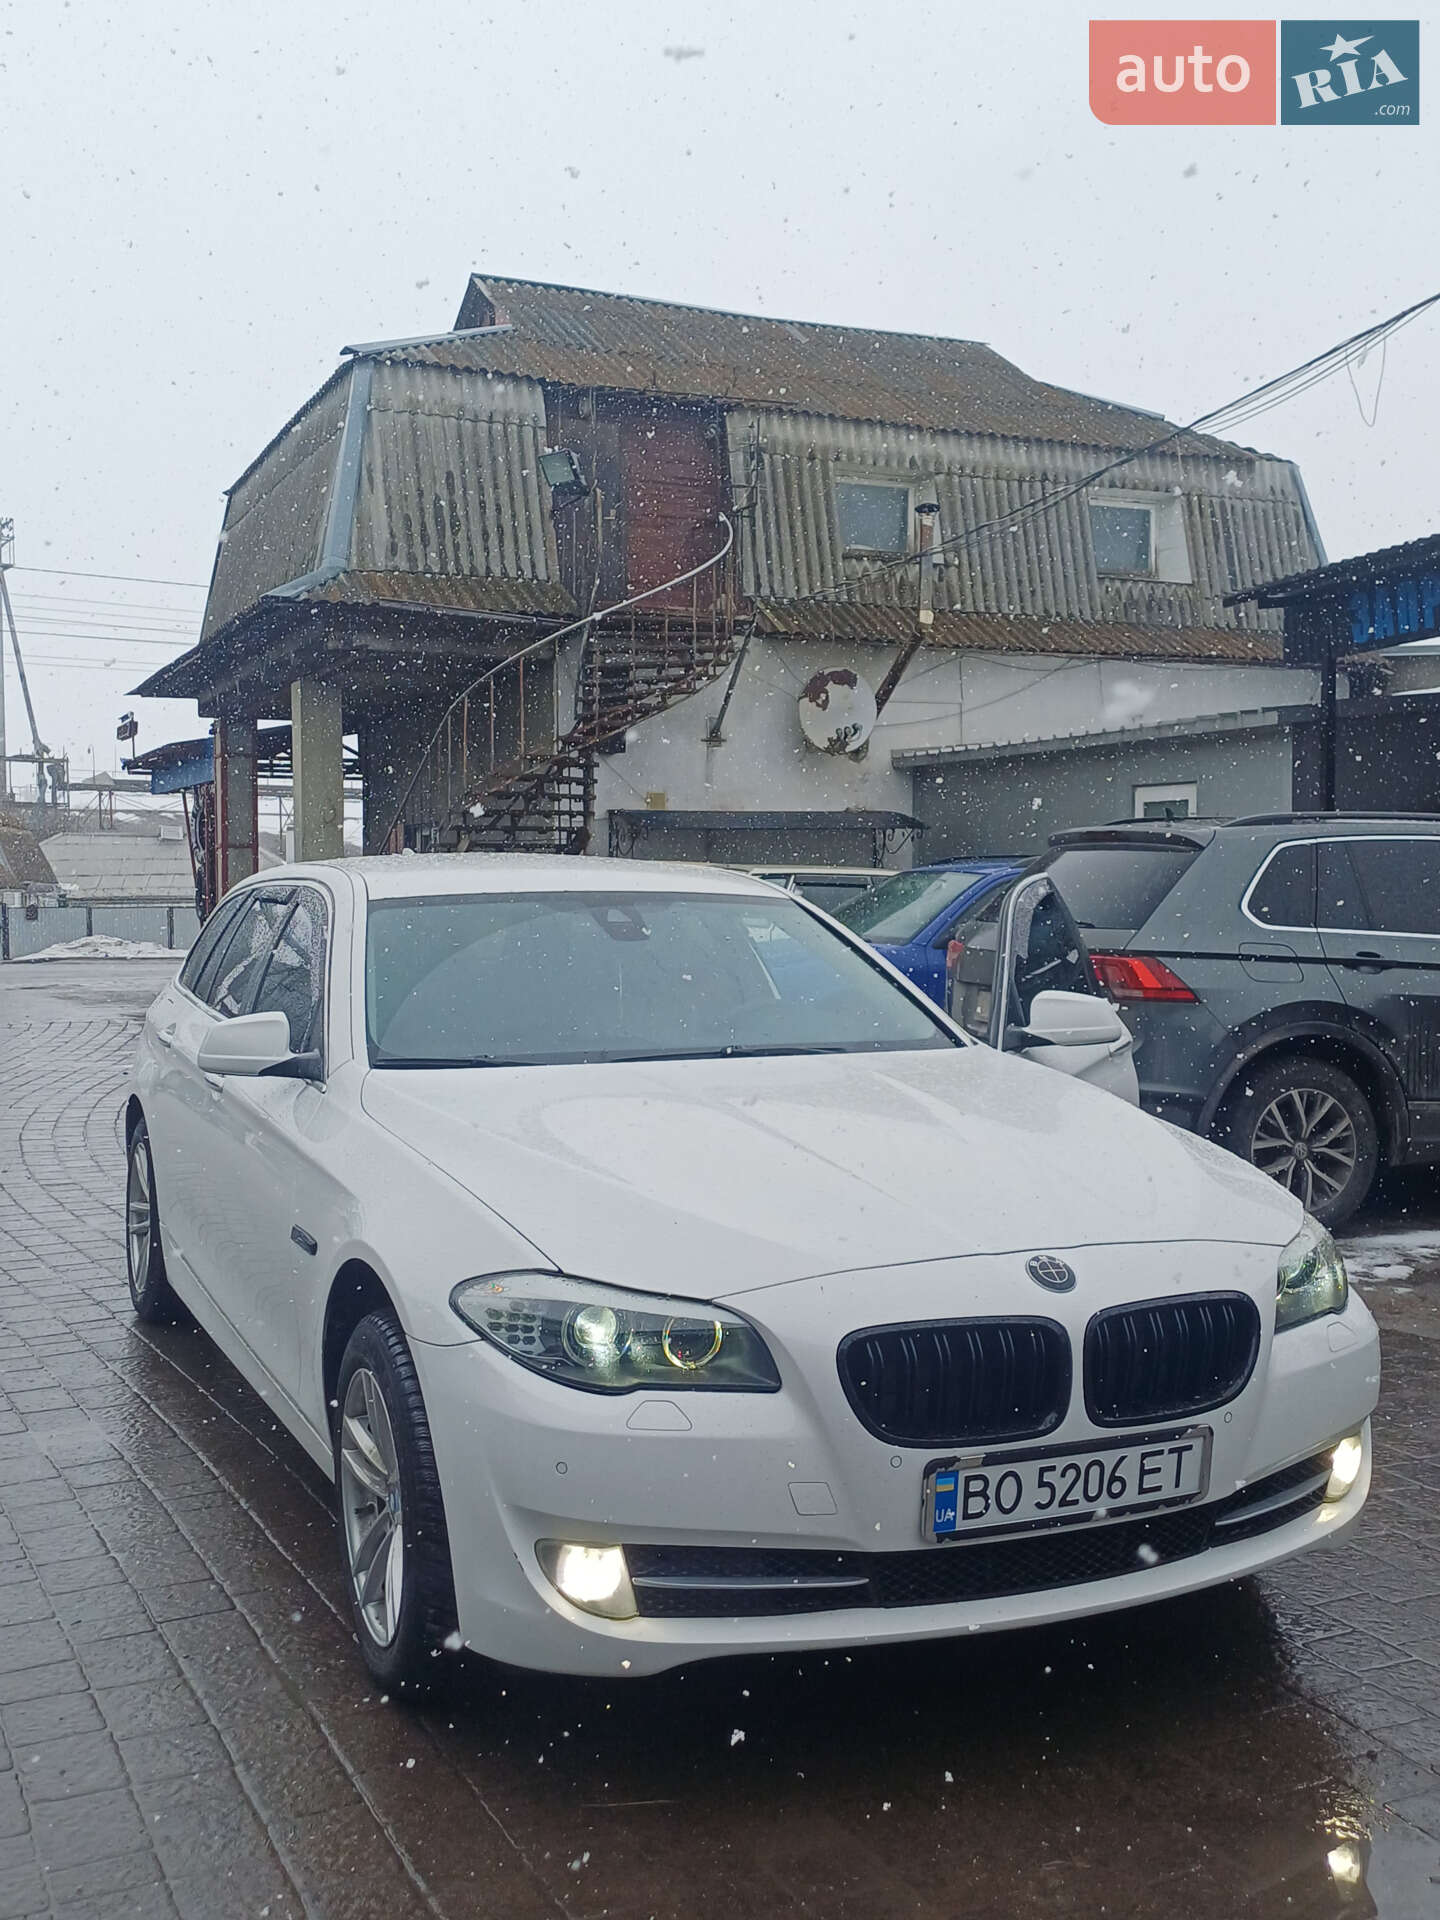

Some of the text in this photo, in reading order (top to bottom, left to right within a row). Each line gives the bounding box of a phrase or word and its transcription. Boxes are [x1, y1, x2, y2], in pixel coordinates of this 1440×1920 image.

[962, 1444, 1194, 1521] BO 5206 ET
[935, 1508, 955, 1523] UA
